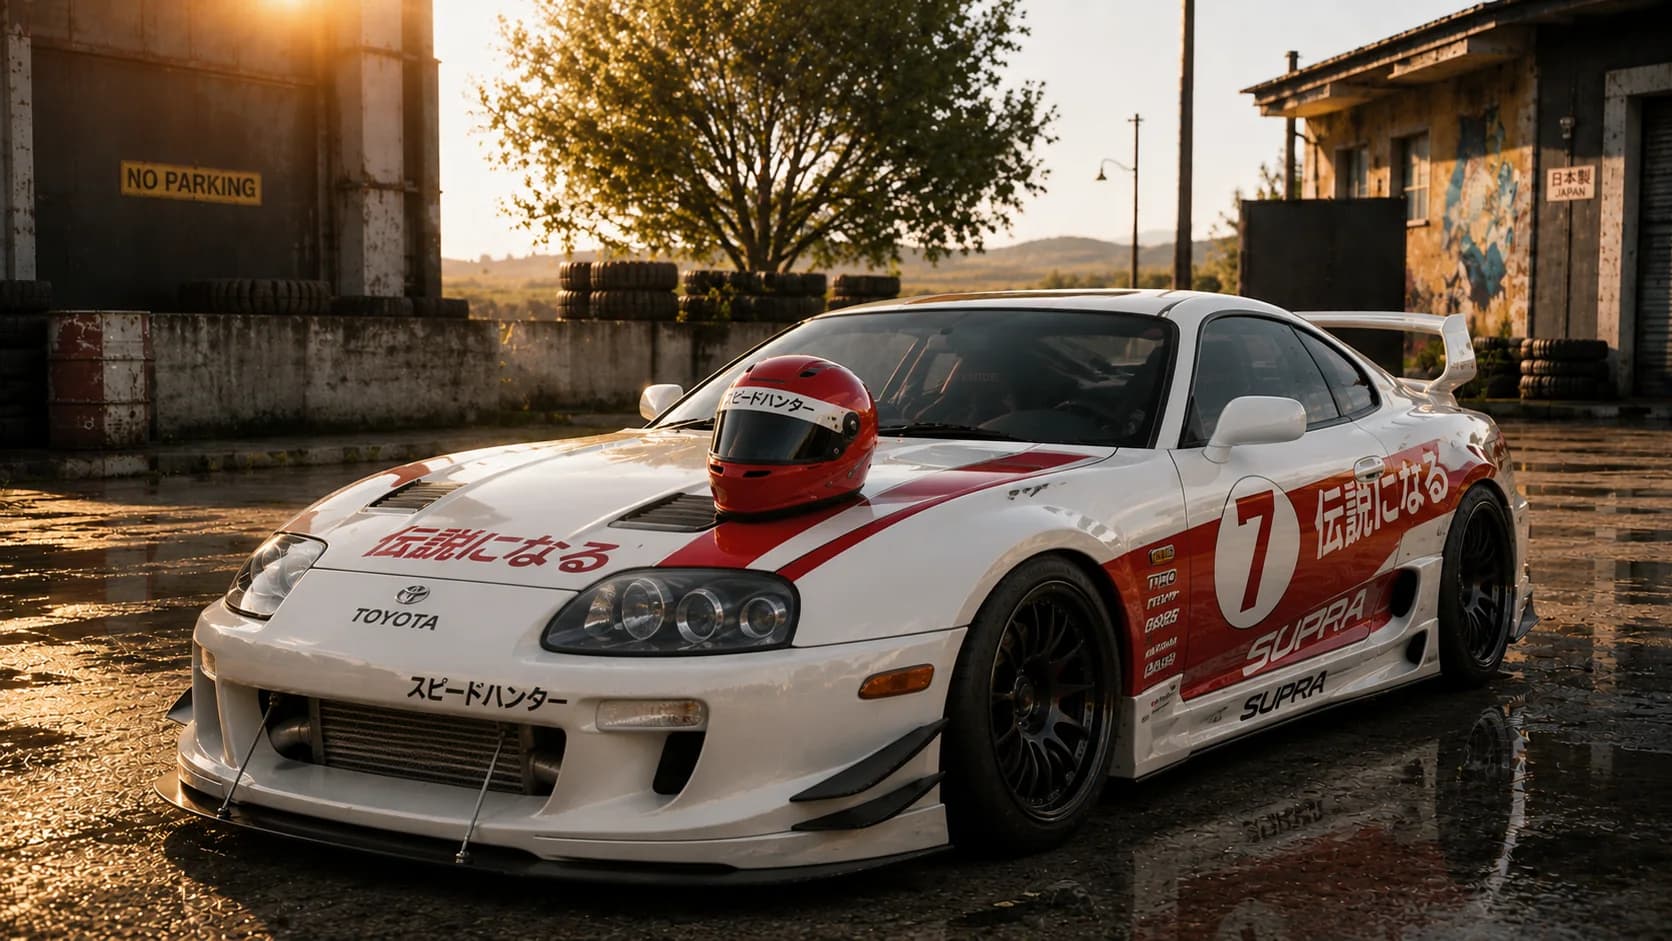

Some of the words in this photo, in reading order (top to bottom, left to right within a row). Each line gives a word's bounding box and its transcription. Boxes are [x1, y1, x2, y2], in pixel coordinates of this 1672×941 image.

[127, 167, 158, 190] NO
[165, 171, 256, 198] PARKING
[1552, 168, 1591, 187] 日本製
[1555, 187, 1586, 198] JAPAN
[1315, 451, 1449, 560] 伝説になる
[361, 525, 620, 573] 伝説になる
[1235, 489, 1275, 613] 7
[351, 608, 439, 631] TOYOTA
[1242, 588, 1368, 677] SUPRA
[407, 676, 568, 711] スピードハンター
[1240, 670, 1328, 721] SUPRA
